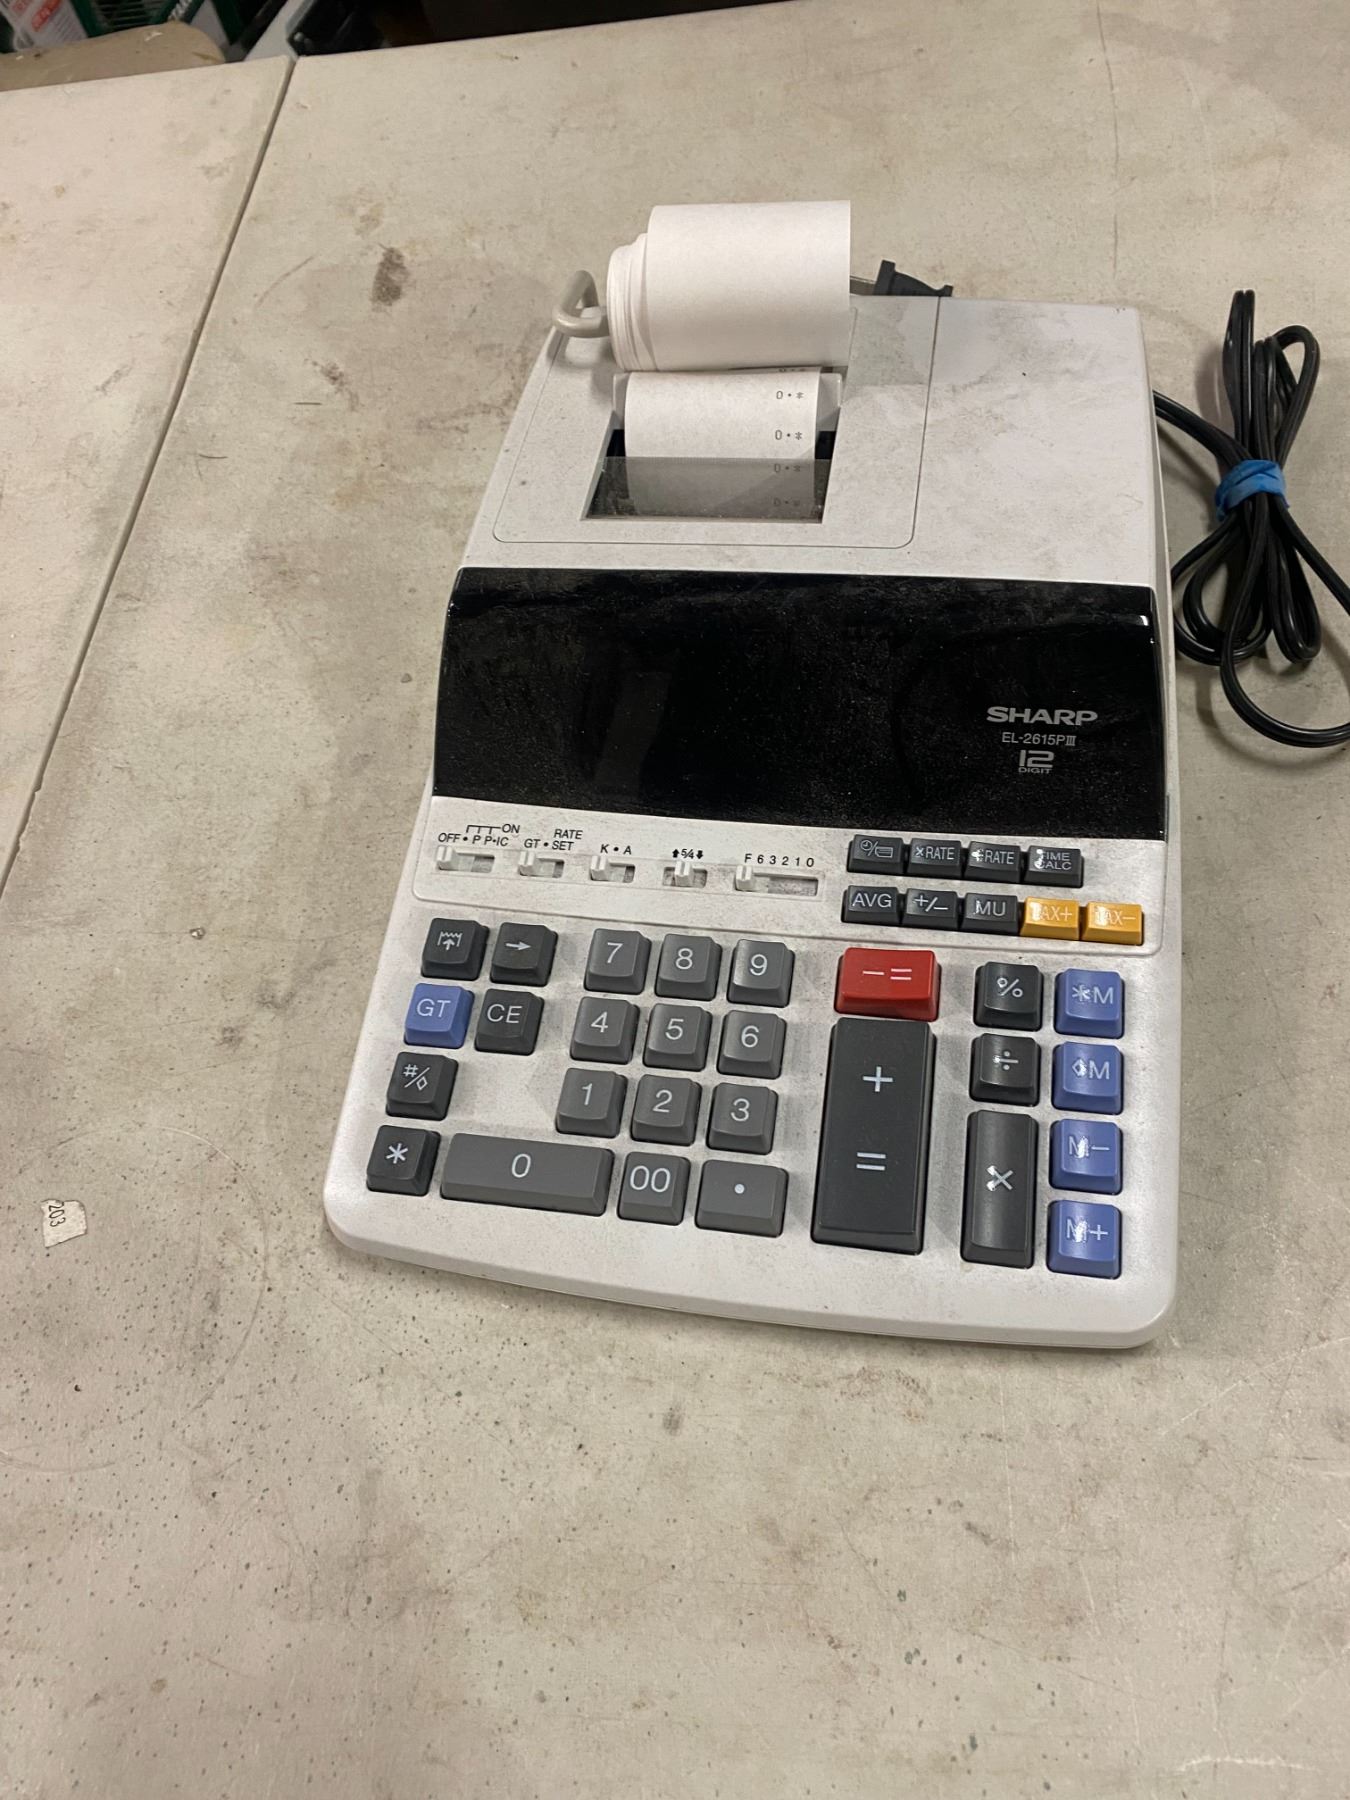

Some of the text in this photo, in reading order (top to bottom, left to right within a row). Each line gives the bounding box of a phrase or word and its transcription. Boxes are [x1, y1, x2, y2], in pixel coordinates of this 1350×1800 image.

[986, 706, 1098, 726] SHARP
[1019, 750, 1054, 768] 12
[438, 832, 461, 844] OFF
[502, 824, 520, 834] ON
[554, 828, 583, 840] RATE
[524, 838, 574, 851] GT SET
[852, 893, 892, 908] AVG
[975, 900, 1006, 916] MU
[606, 942, 623, 964] 7
[675, 948, 693, 970] 8
[750, 954, 768, 976] 9
[416, 998, 451, 1018] GT
[487, 1004, 522, 1024] CE
[591, 1012, 608, 1033] 4
[665, 1018, 684, 1040] 5
[741, 1025, 760, 1048] 6
[582, 1082, 592, 1106] 1
[652, 1090, 672, 1113] 2
[730, 1098, 750, 1122] 3
[511, 1154, 532, 1178] 0
[630, 1166, 672, 1192] 00
[48, 1202, 66, 1227] 203
